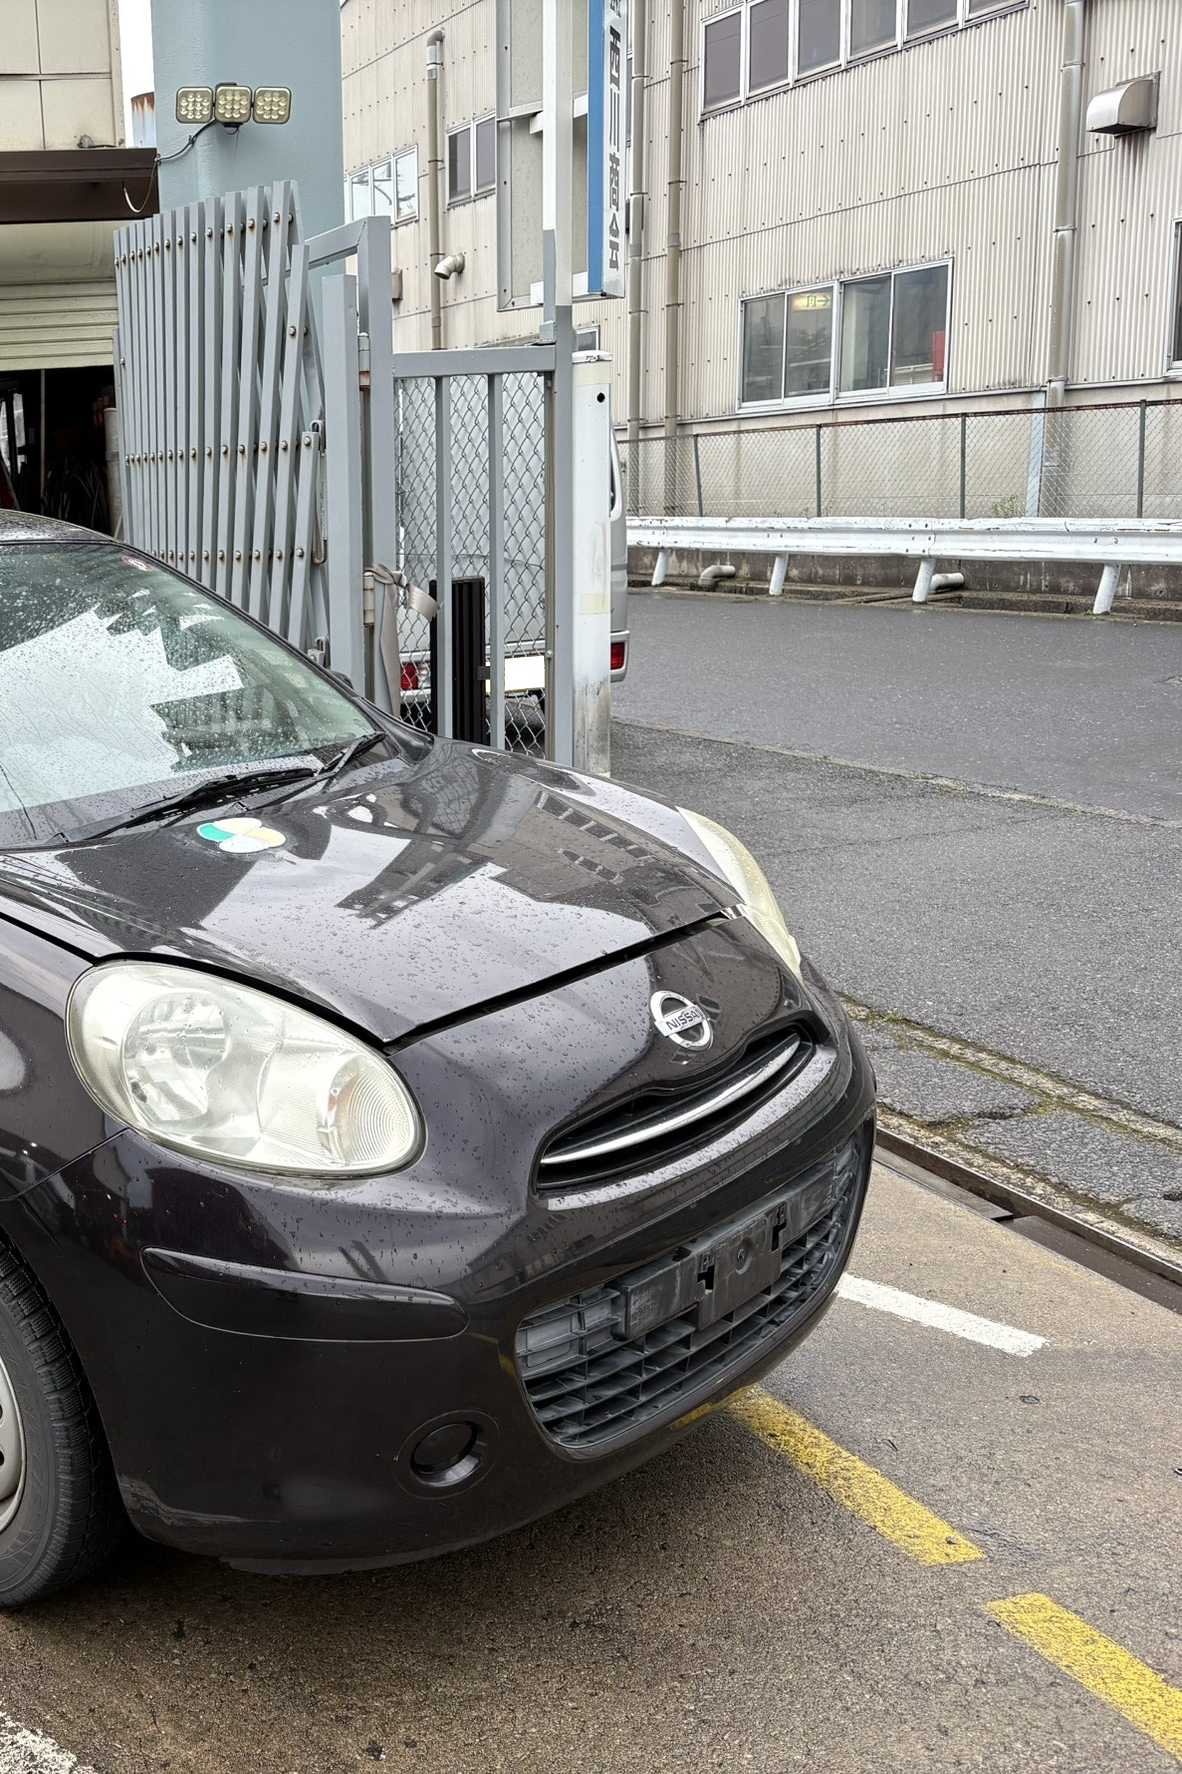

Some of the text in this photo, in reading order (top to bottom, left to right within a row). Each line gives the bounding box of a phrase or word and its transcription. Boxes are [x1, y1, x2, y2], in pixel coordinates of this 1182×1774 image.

[609, 0, 621, 271] 西川商会
[665, 1010, 705, 1031] NISSAN
